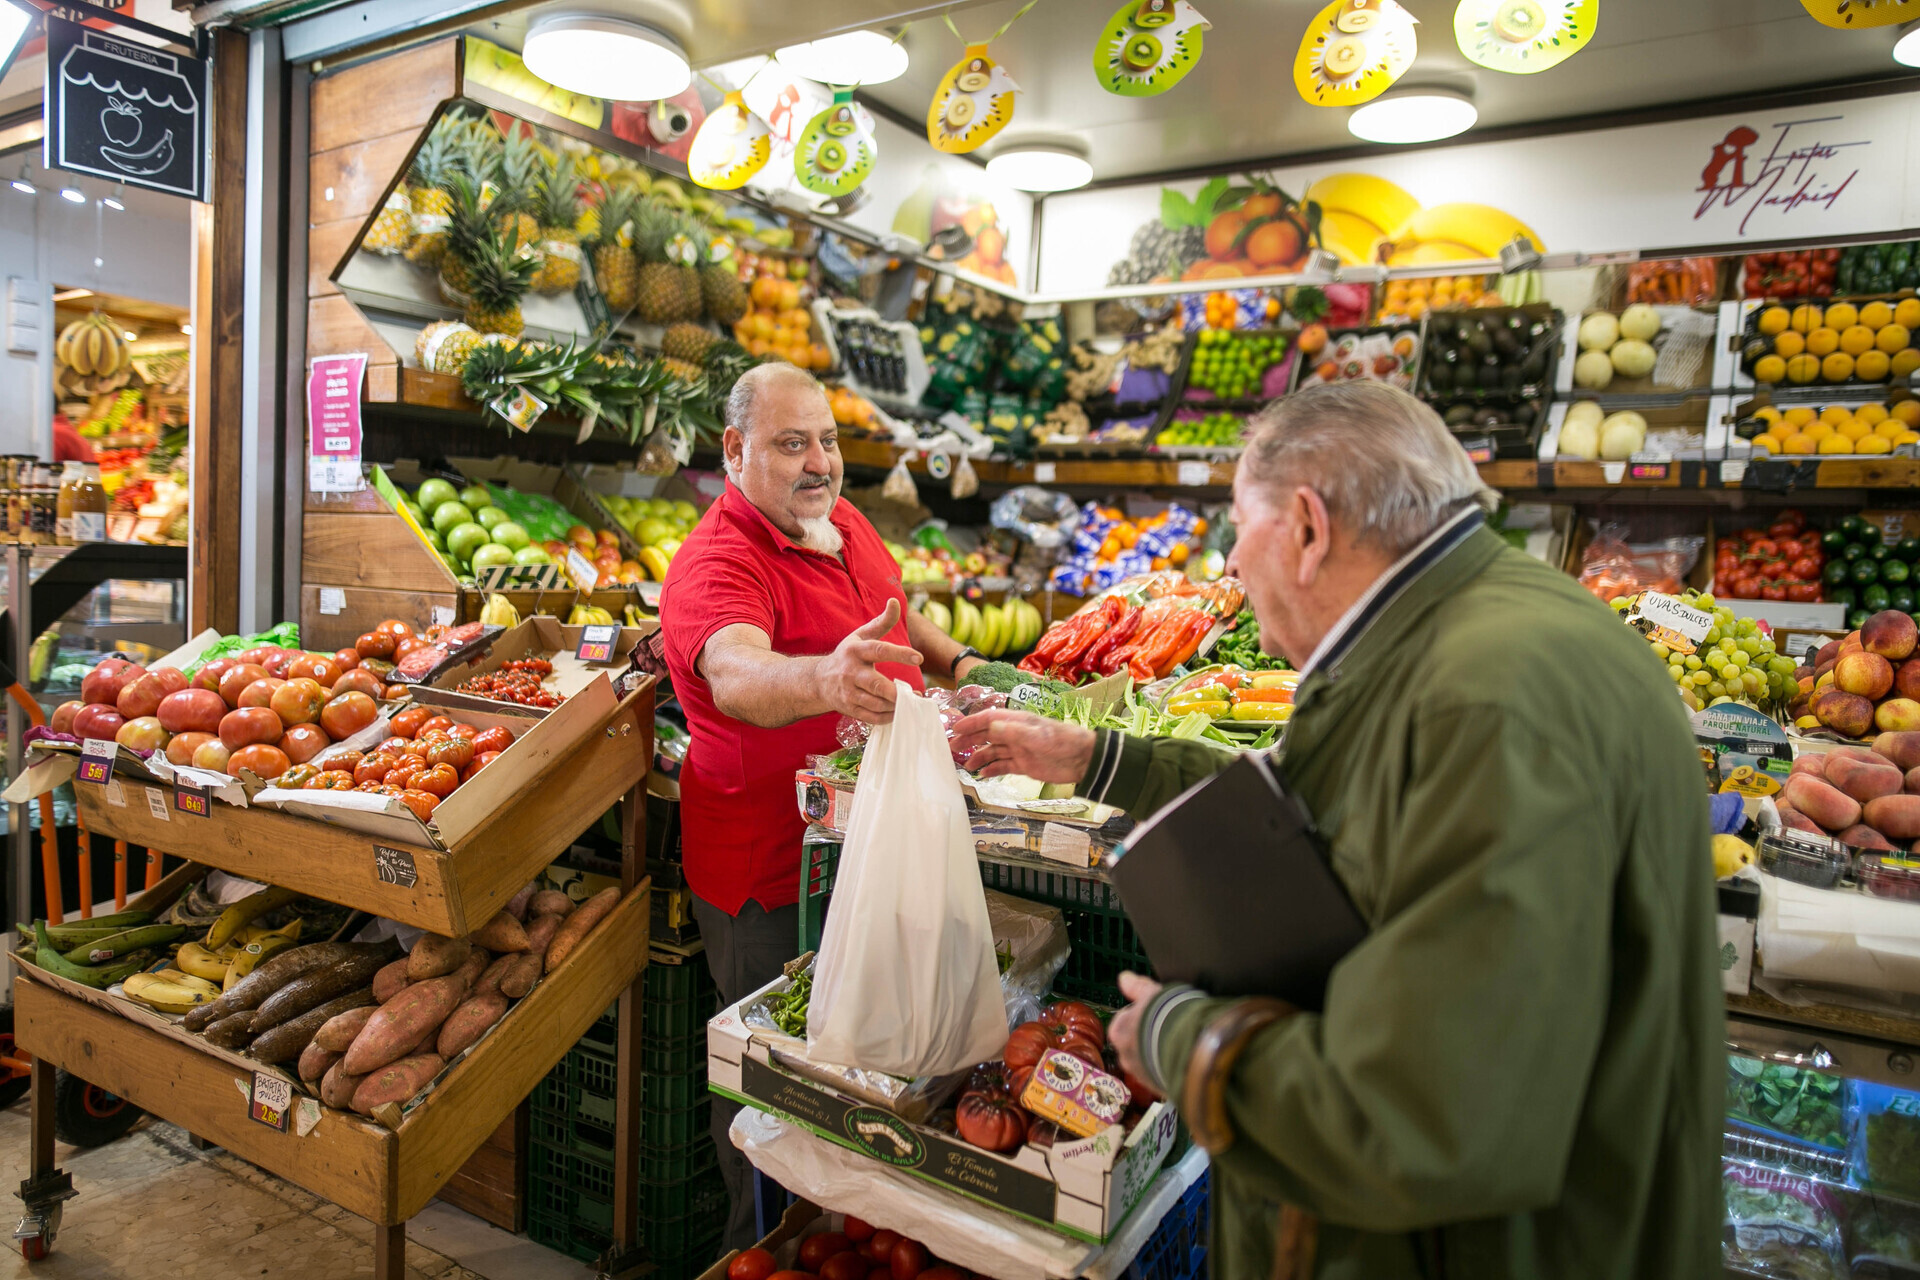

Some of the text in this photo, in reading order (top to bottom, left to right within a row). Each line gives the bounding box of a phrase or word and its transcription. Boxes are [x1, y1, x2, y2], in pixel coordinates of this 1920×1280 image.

[1693, 165, 1859, 236] Madrid
[1649, 595, 1681, 616] UVAS
[1678, 609, 1711, 629] DULCES
[1702, 719, 1772, 737] PARQUE NATURAL
[1706, 712, 1768, 727] GANA UN VIAJE
[1053, 1055, 1082, 1074] sabor
[1046, 1071, 1074, 1091] salud
[854, 1133, 880, 1158] TIERRA
[881, 1152, 892, 1163] DE
[857, 1122, 913, 1155] CEBREROS
[944, 1165, 957, 1177] de
[962, 1156, 997, 1179] Tomate
